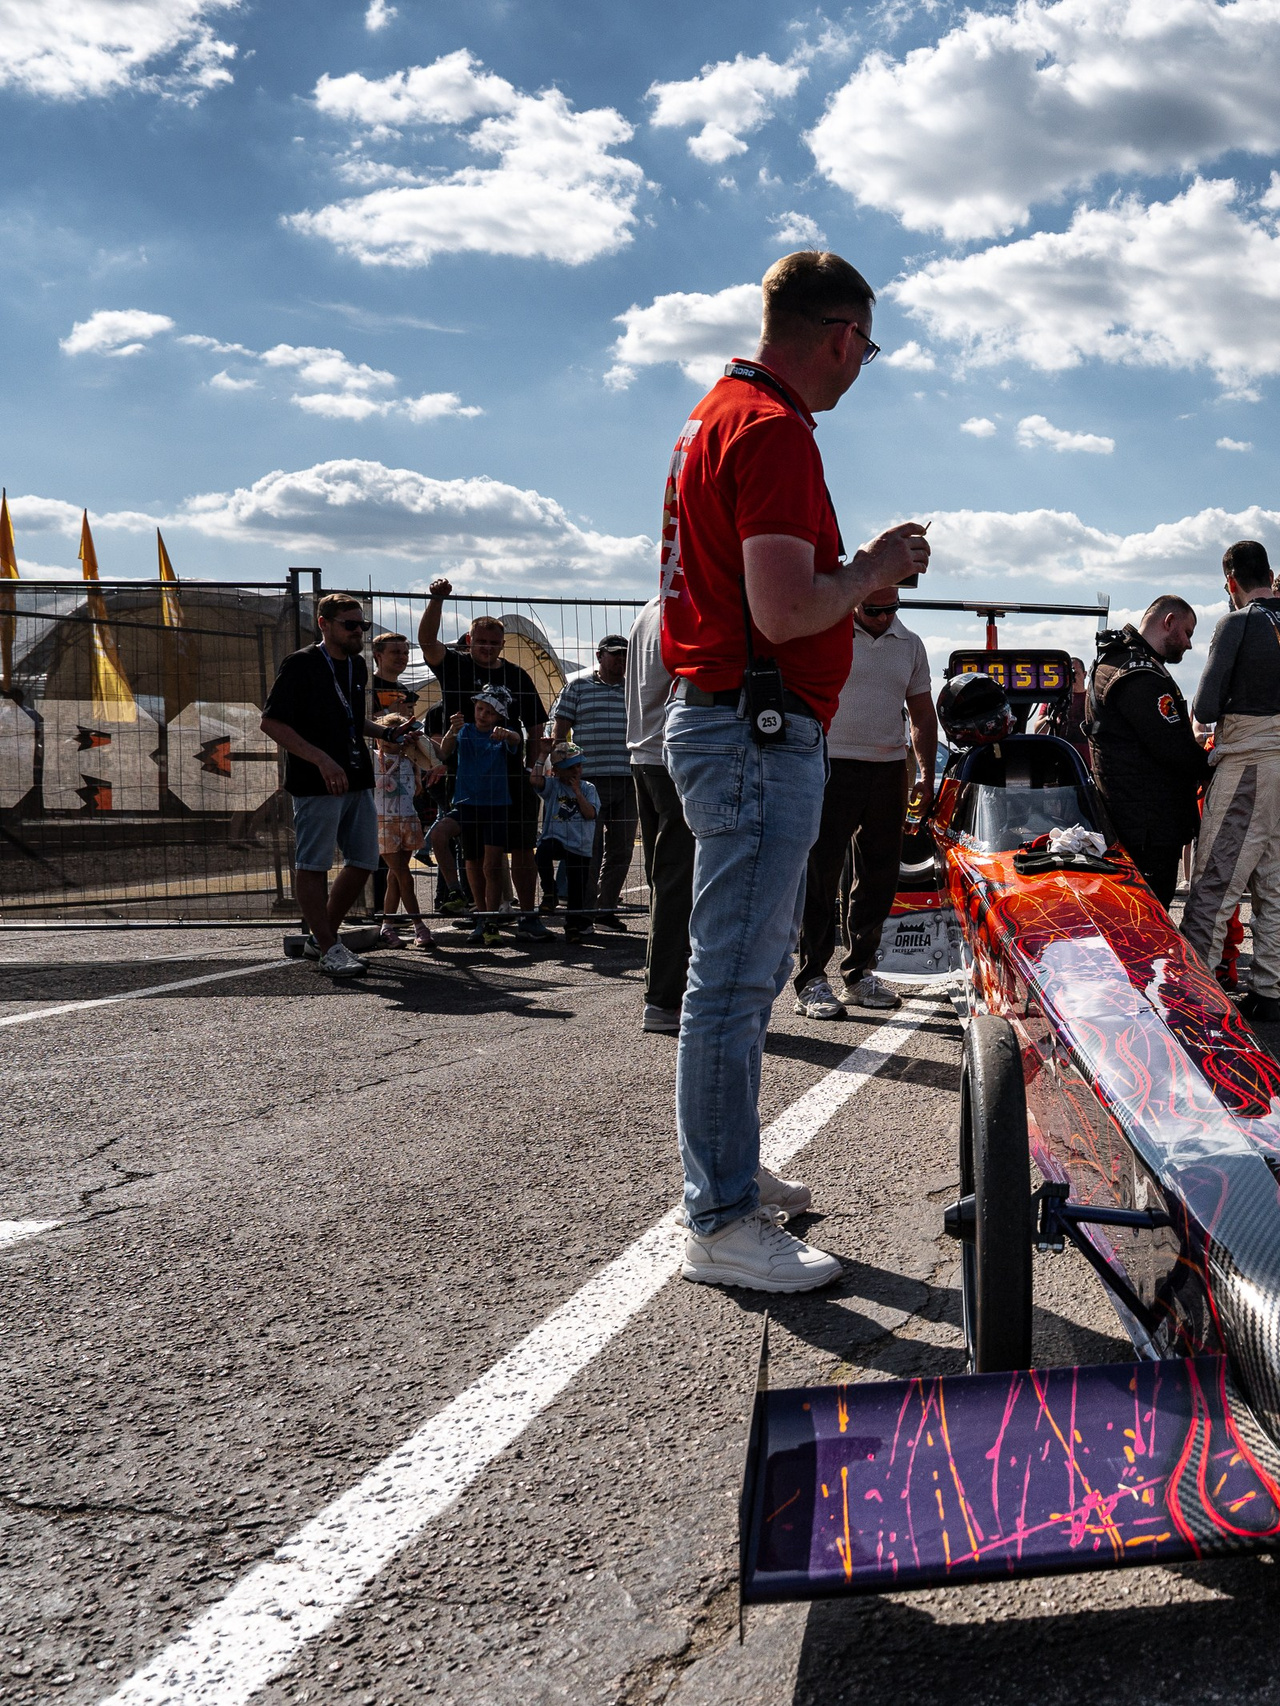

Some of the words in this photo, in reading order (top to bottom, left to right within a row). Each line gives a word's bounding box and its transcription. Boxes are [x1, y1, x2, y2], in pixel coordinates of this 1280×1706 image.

[733, 366, 755, 377] RDRC
[762, 717, 777, 727] 253
[895, 934, 931, 947] ORILLA
